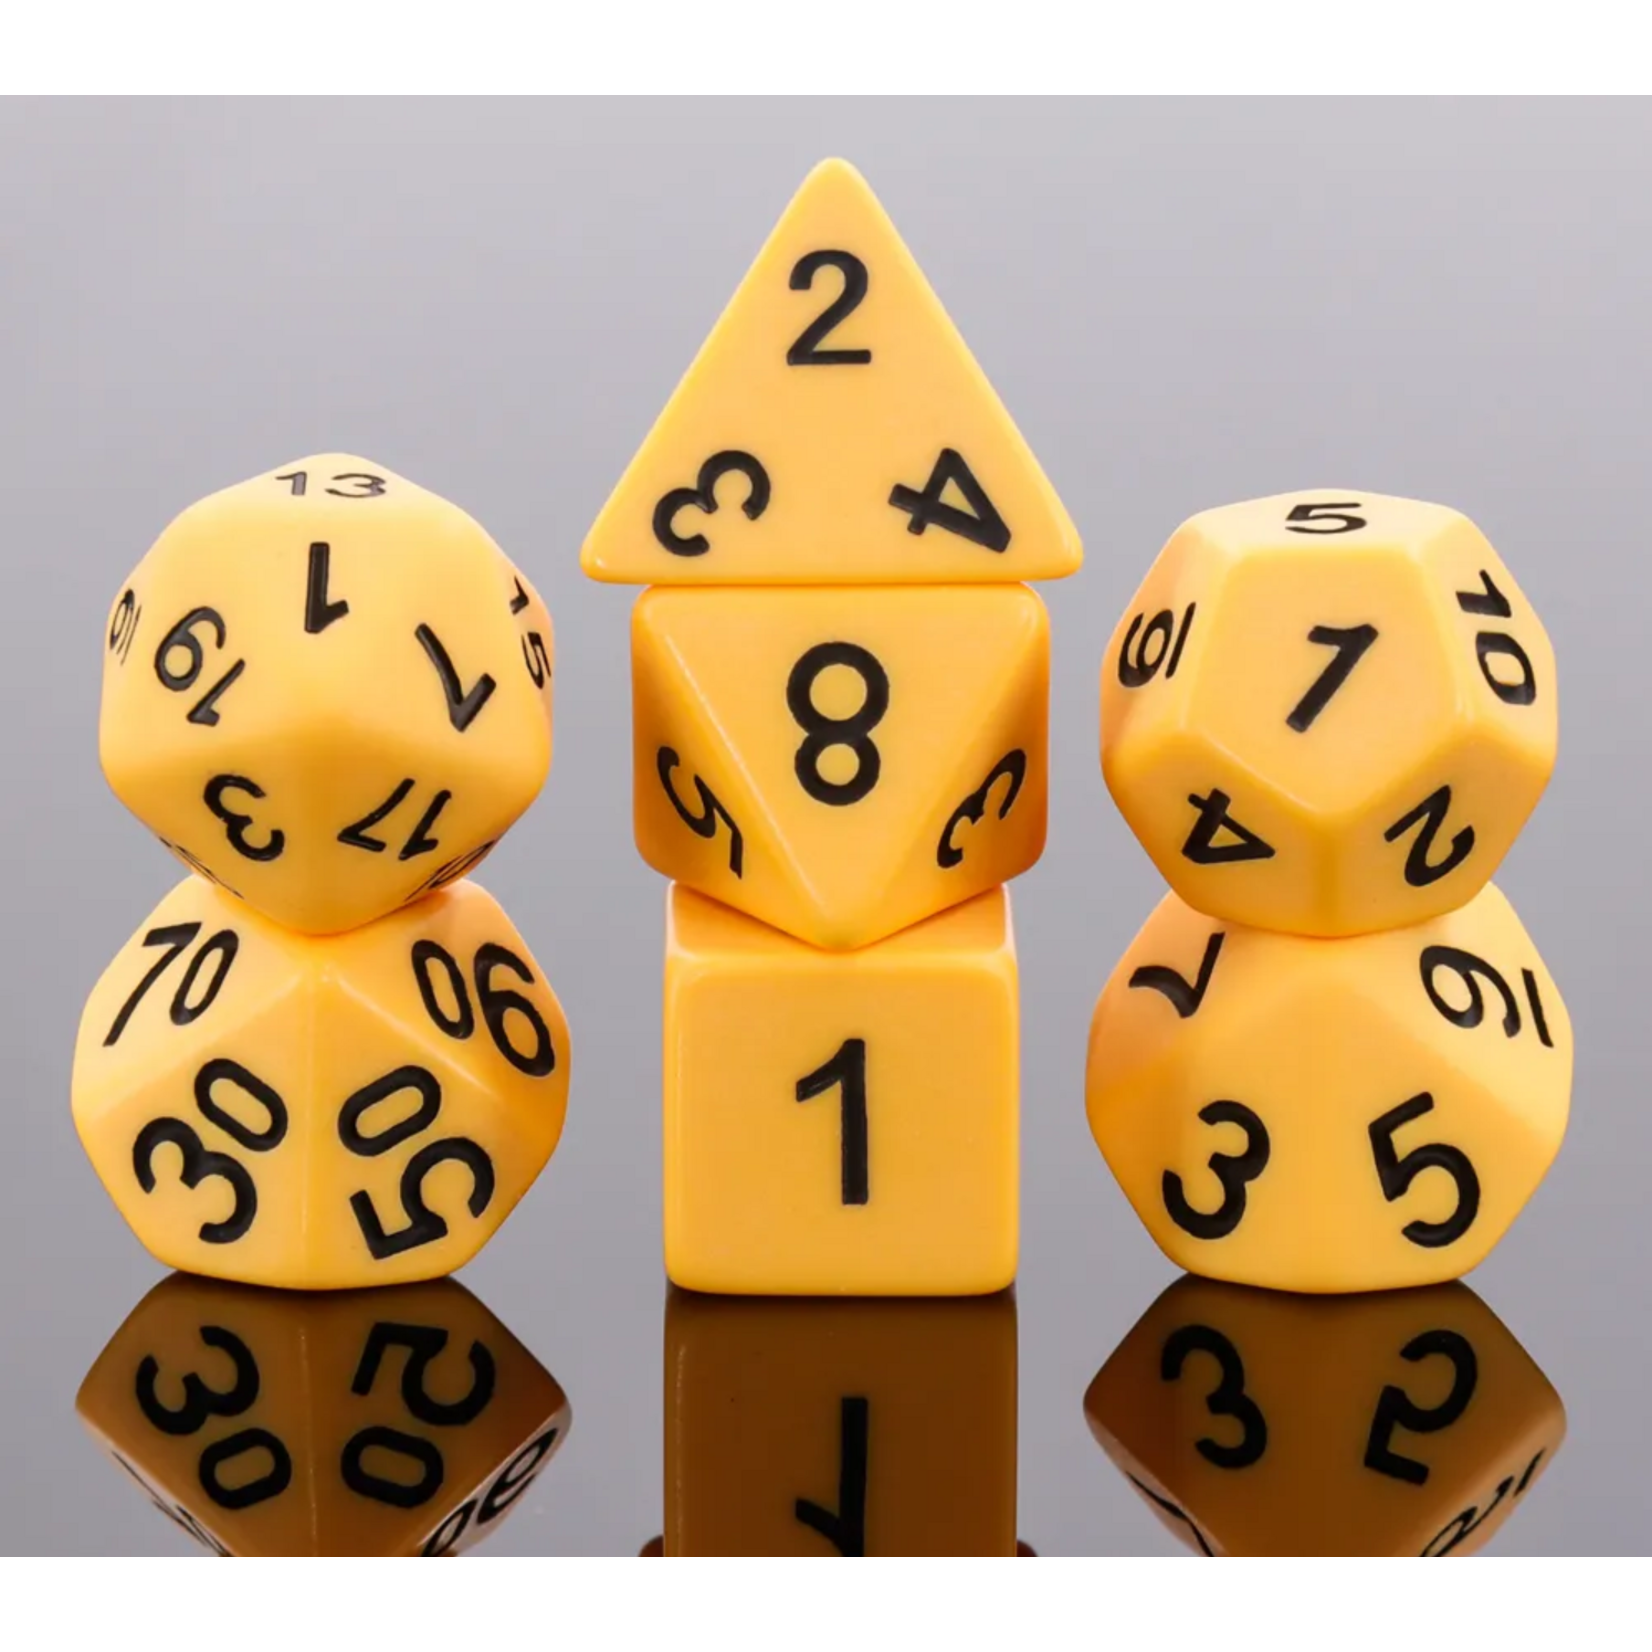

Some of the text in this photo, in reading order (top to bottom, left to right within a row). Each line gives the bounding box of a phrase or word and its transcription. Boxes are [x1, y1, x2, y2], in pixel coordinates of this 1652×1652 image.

[787, 249, 872, 366] 2
[275, 470, 387, 499] 13
[652, 450, 771, 557] 3
[889, 448, 1011, 553] 4
[1284, 503, 1367, 535] 5
[304, 541, 350, 634] 1
[509, 574, 552, 690] 15
[1456, 569, 1537, 706] 10
[153, 606, 247, 728] 19
[414, 623, 497, 732] 7
[786, 642, 889, 806] 8
[1285, 623, 1379, 733] 1
[203, 774, 286, 863] 3
[338, 778, 453, 861] 17
[656, 745, 743, 879] 5
[937, 748, 1027, 869] 3
[1181, 788, 1276, 866] 4
[1383, 784, 1476, 888] 2
[103, 921, 239, 1047] 70
[1129, 931, 1225, 1019] 7
[132, 1057, 289, 1245] 30
[337, 1064, 496, 1260] 50
[795, 1037, 869, 1206] 1
[1161, 1099, 1271, 1240] 3
[1367, 1091, 1482, 1249] 5
